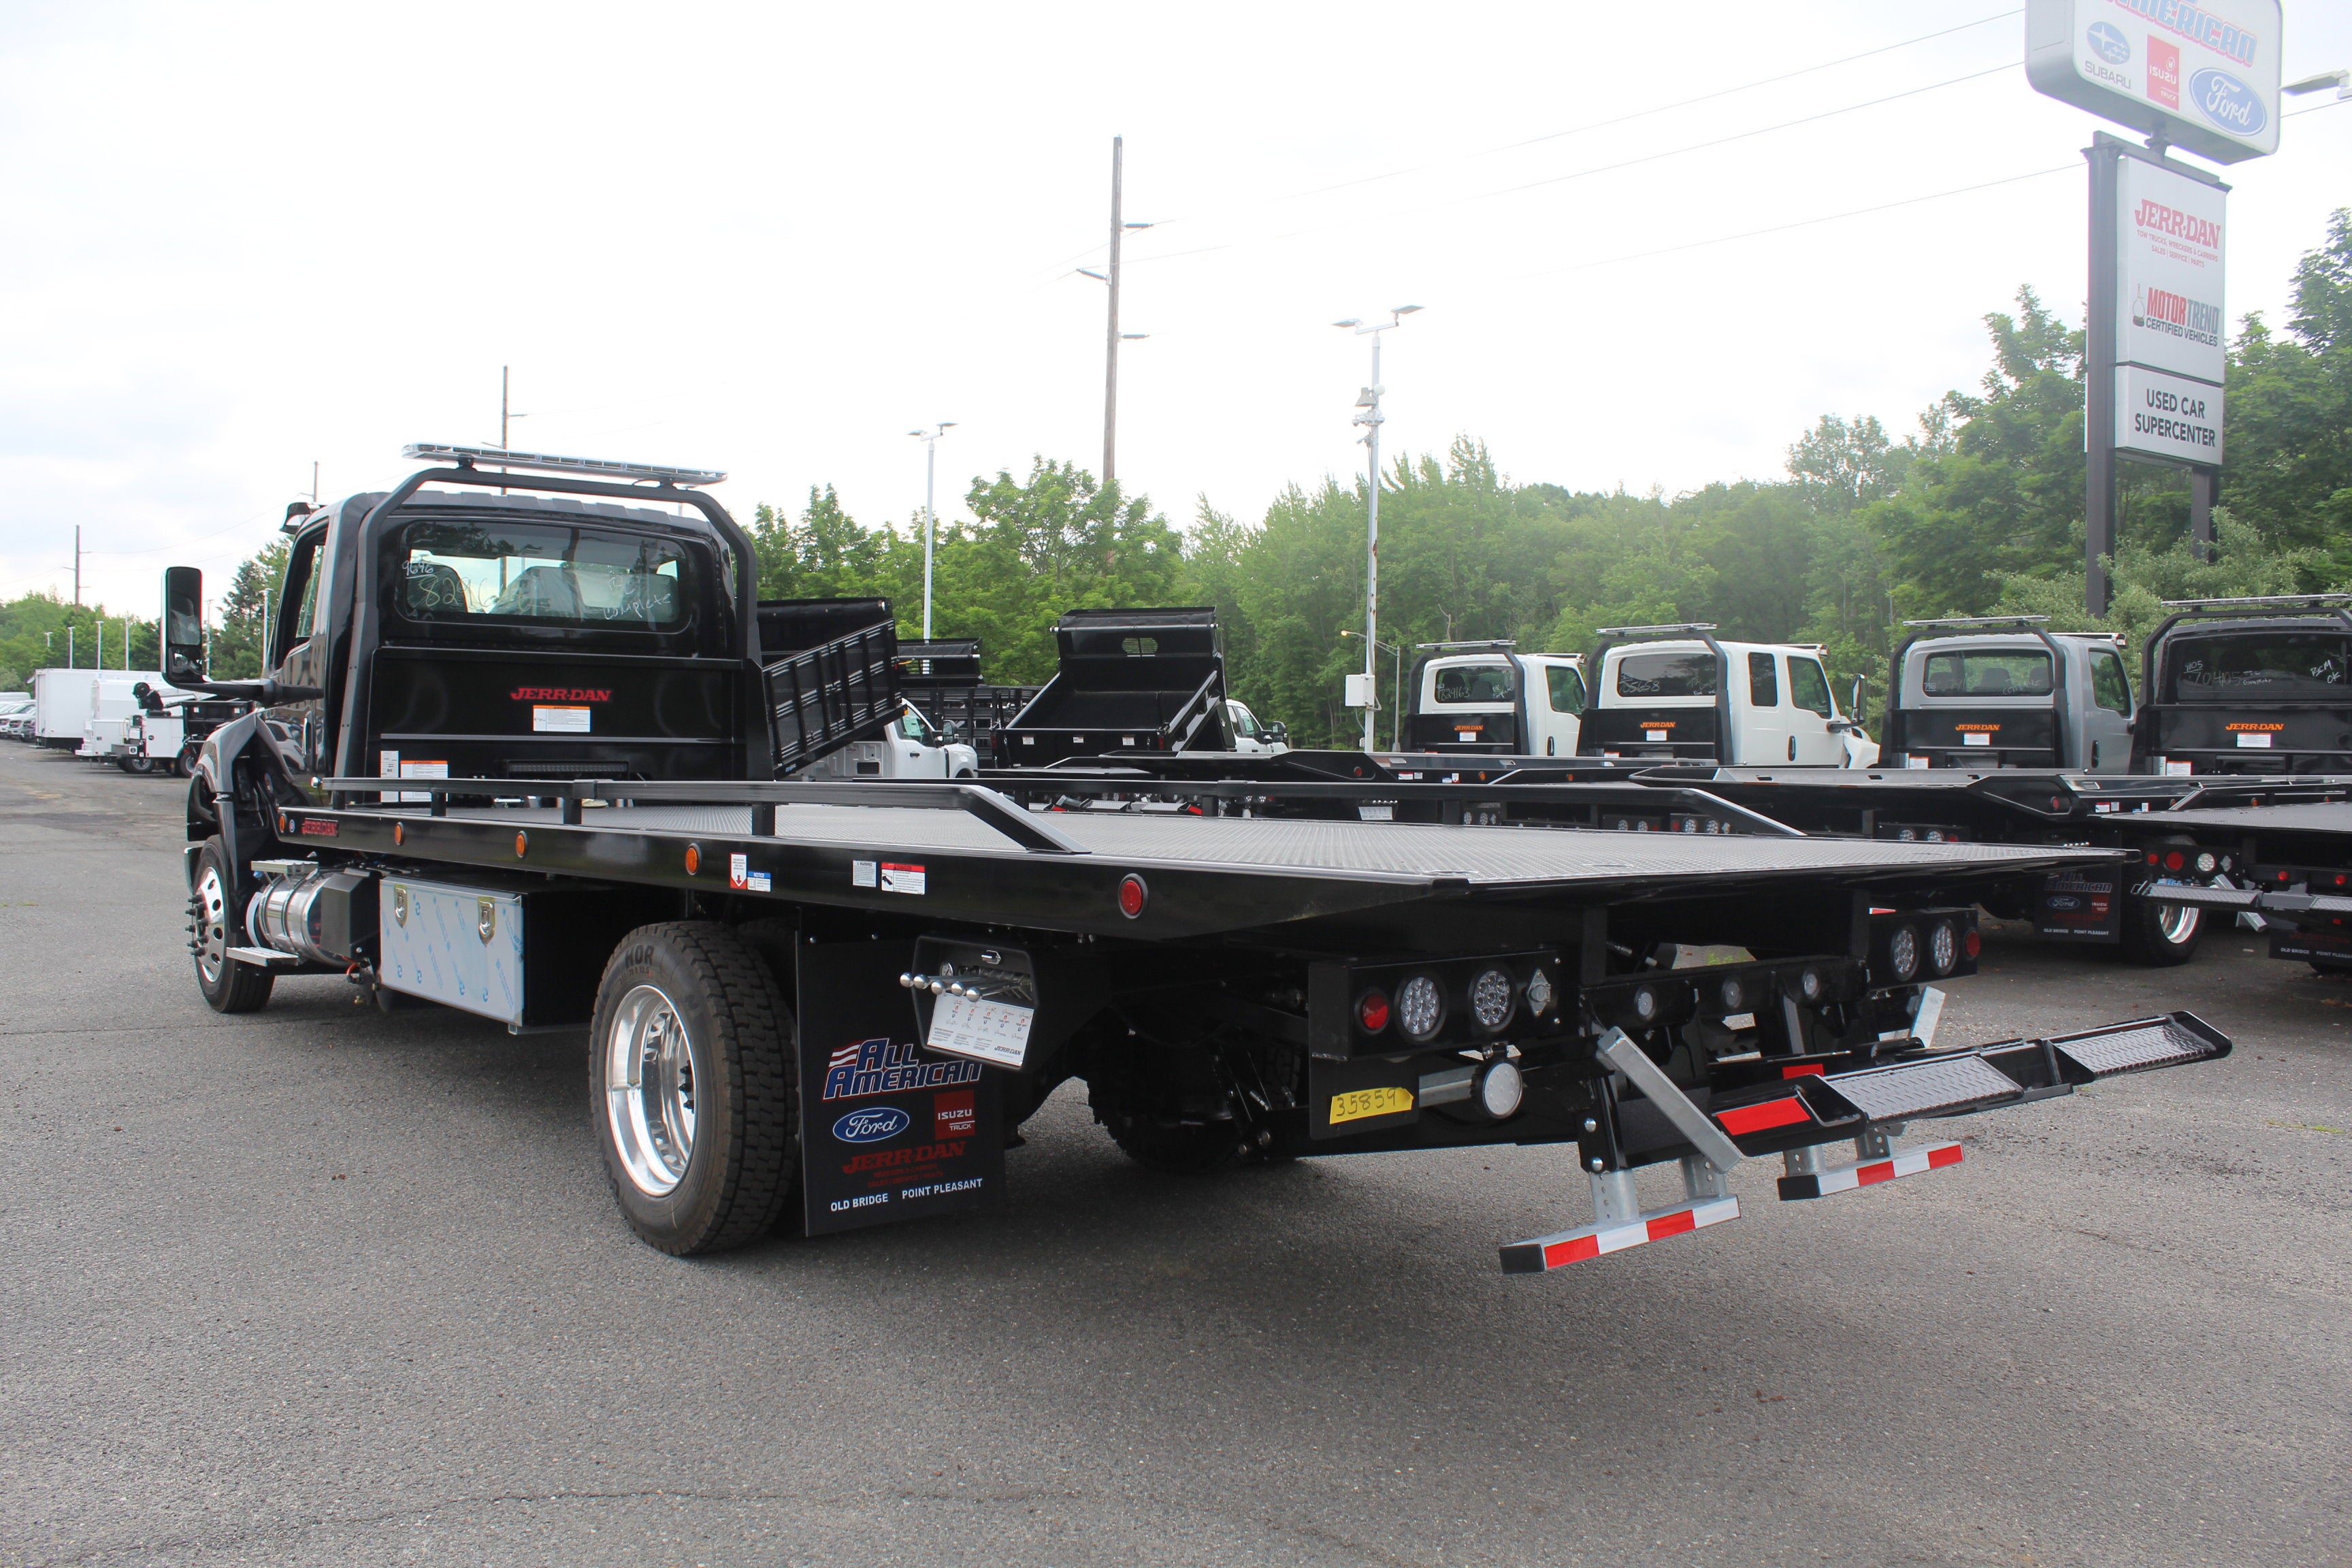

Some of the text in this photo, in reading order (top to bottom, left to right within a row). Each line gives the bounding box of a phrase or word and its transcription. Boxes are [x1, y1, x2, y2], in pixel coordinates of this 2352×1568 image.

[2110, 0, 2257, 66] MERICAN
[2084, 61, 2132, 90] SUBARU
[2149, 65, 2177, 85] ISUZU
[2160, 89, 2177, 101] TRUCK
[2206, 76, 2251, 127] Ford
[2137, 229, 2148, 239] TOW
[2149, 233, 2168, 246] TRUCKS,
[2168, 240, 2193, 254] WRECKERS
[2197, 250, 2218, 262] CARRIERS
[2151, 245, 2204, 268] SALES SERVICE PARTS
[2146, 317, 2218, 347] CERTIFIED VEHICLES
[2146, 388, 2205, 419] USED CAR
[2135, 412, 2215, 448] SUPERCENTER
[2052, 898, 2075, 906] Ford
[854, 1037, 919, 1073] ALL
[822, 1060, 982, 1100] AMERICAN
[937, 1109, 973, 1120] ISUZU
[1335, 1088, 1396, 1117] 35859
[845, 1113, 898, 1139] Ford
[830, 1178, 983, 1212] OLD BRIDGE POINT PLEASANT
